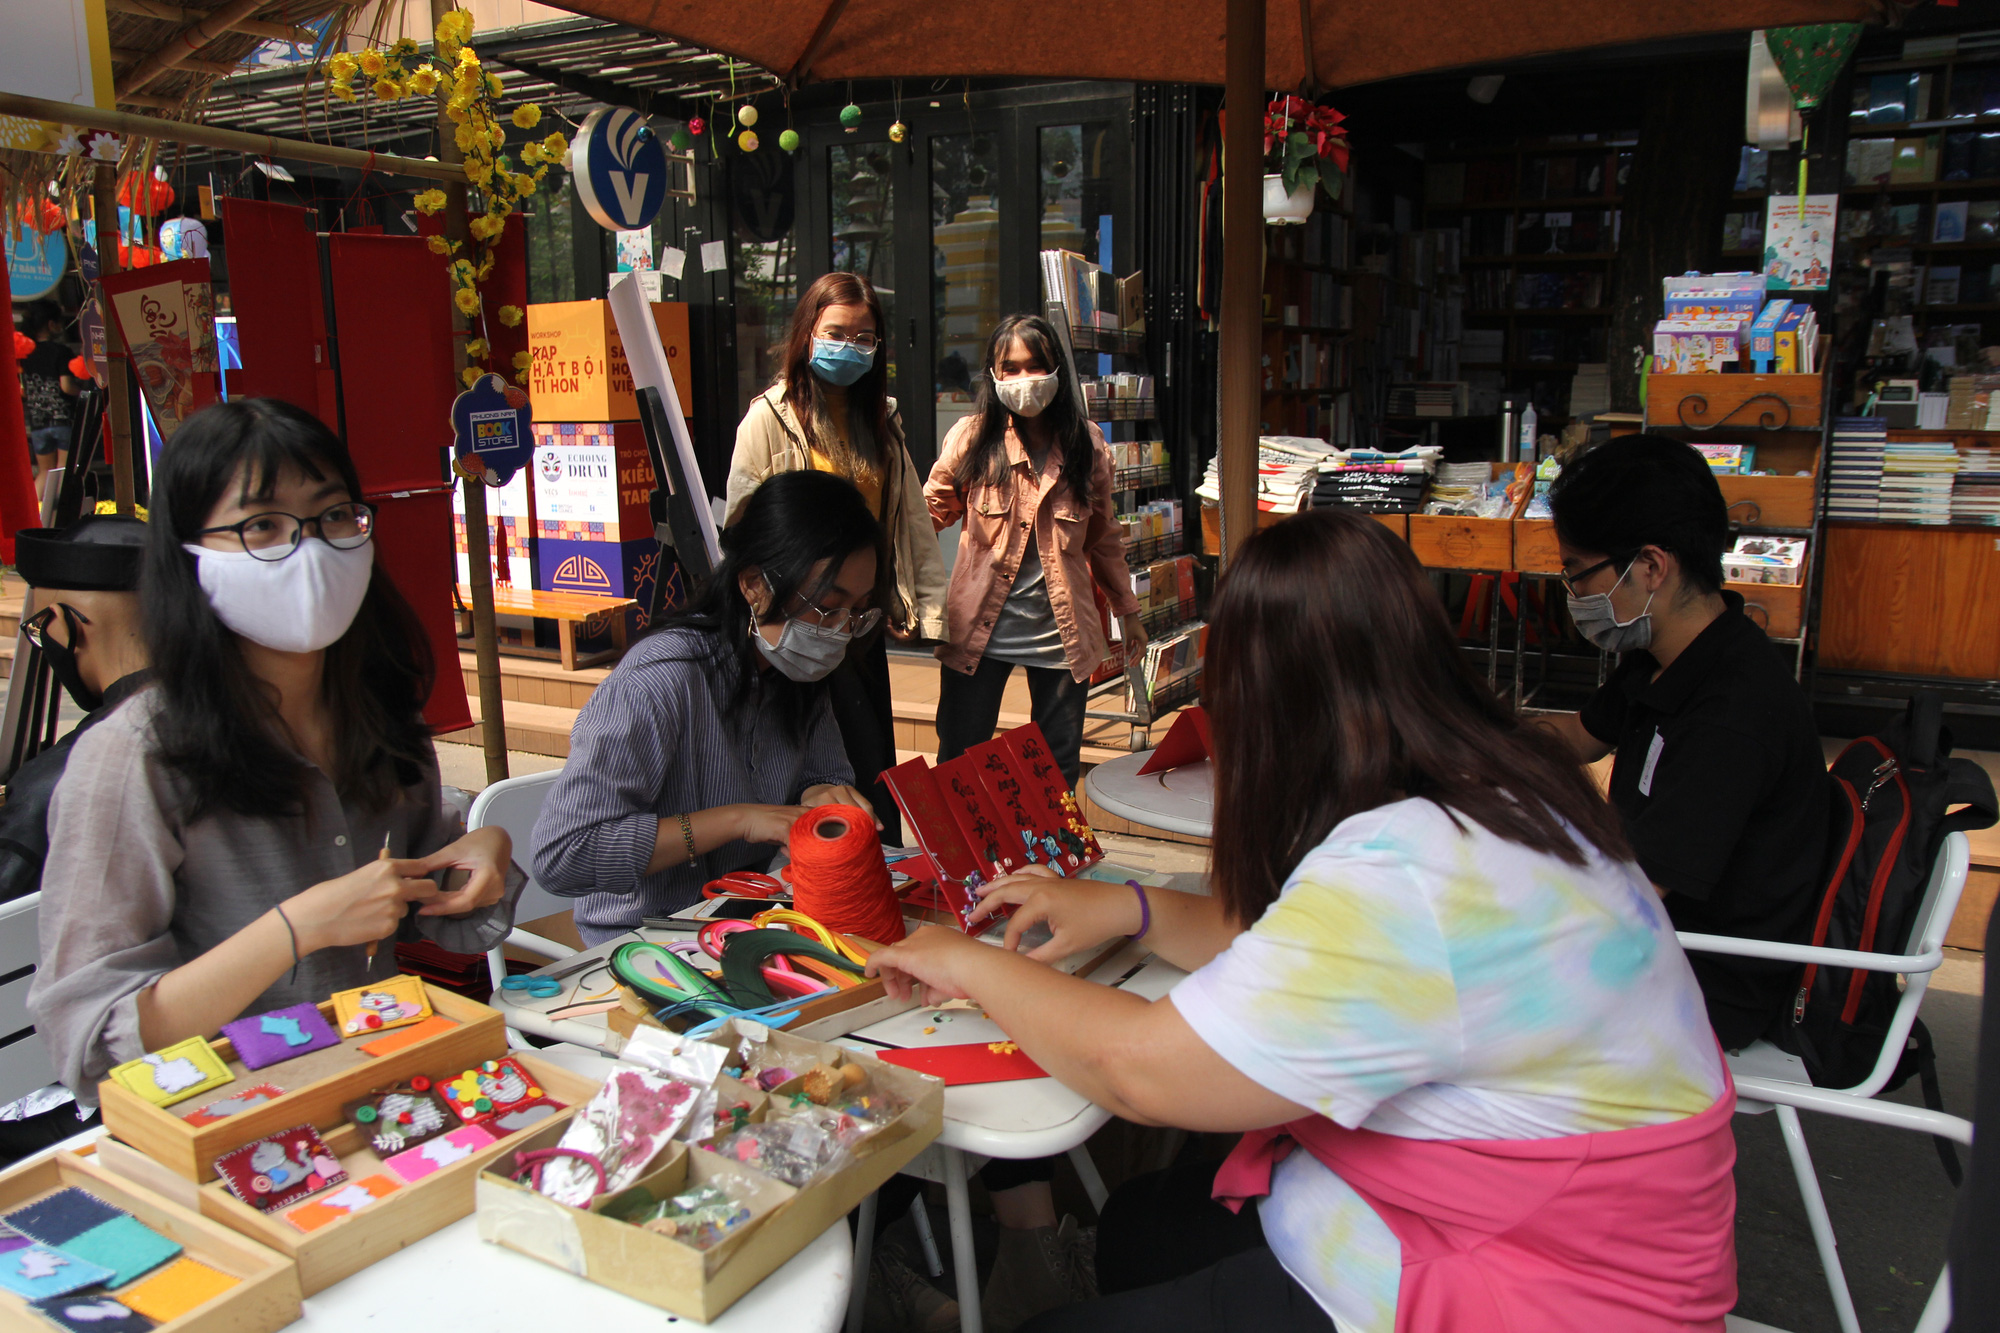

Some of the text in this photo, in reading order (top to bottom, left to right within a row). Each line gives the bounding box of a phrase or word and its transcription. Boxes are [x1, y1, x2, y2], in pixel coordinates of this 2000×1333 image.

[608, 170, 649, 225] V
[531, 331, 561, 339] WORKSHOP
[532, 345, 557, 363] RẠP
[572, 355, 604, 379] BỘI
[534, 374, 579, 393] TÍ HON
[477, 421, 512, 438] BOOK
[478, 435, 513, 447] STORE
[568, 454, 607, 462] ECHOING
[569, 465, 607, 478] DRUM
[623, 488, 657, 505] TAR
